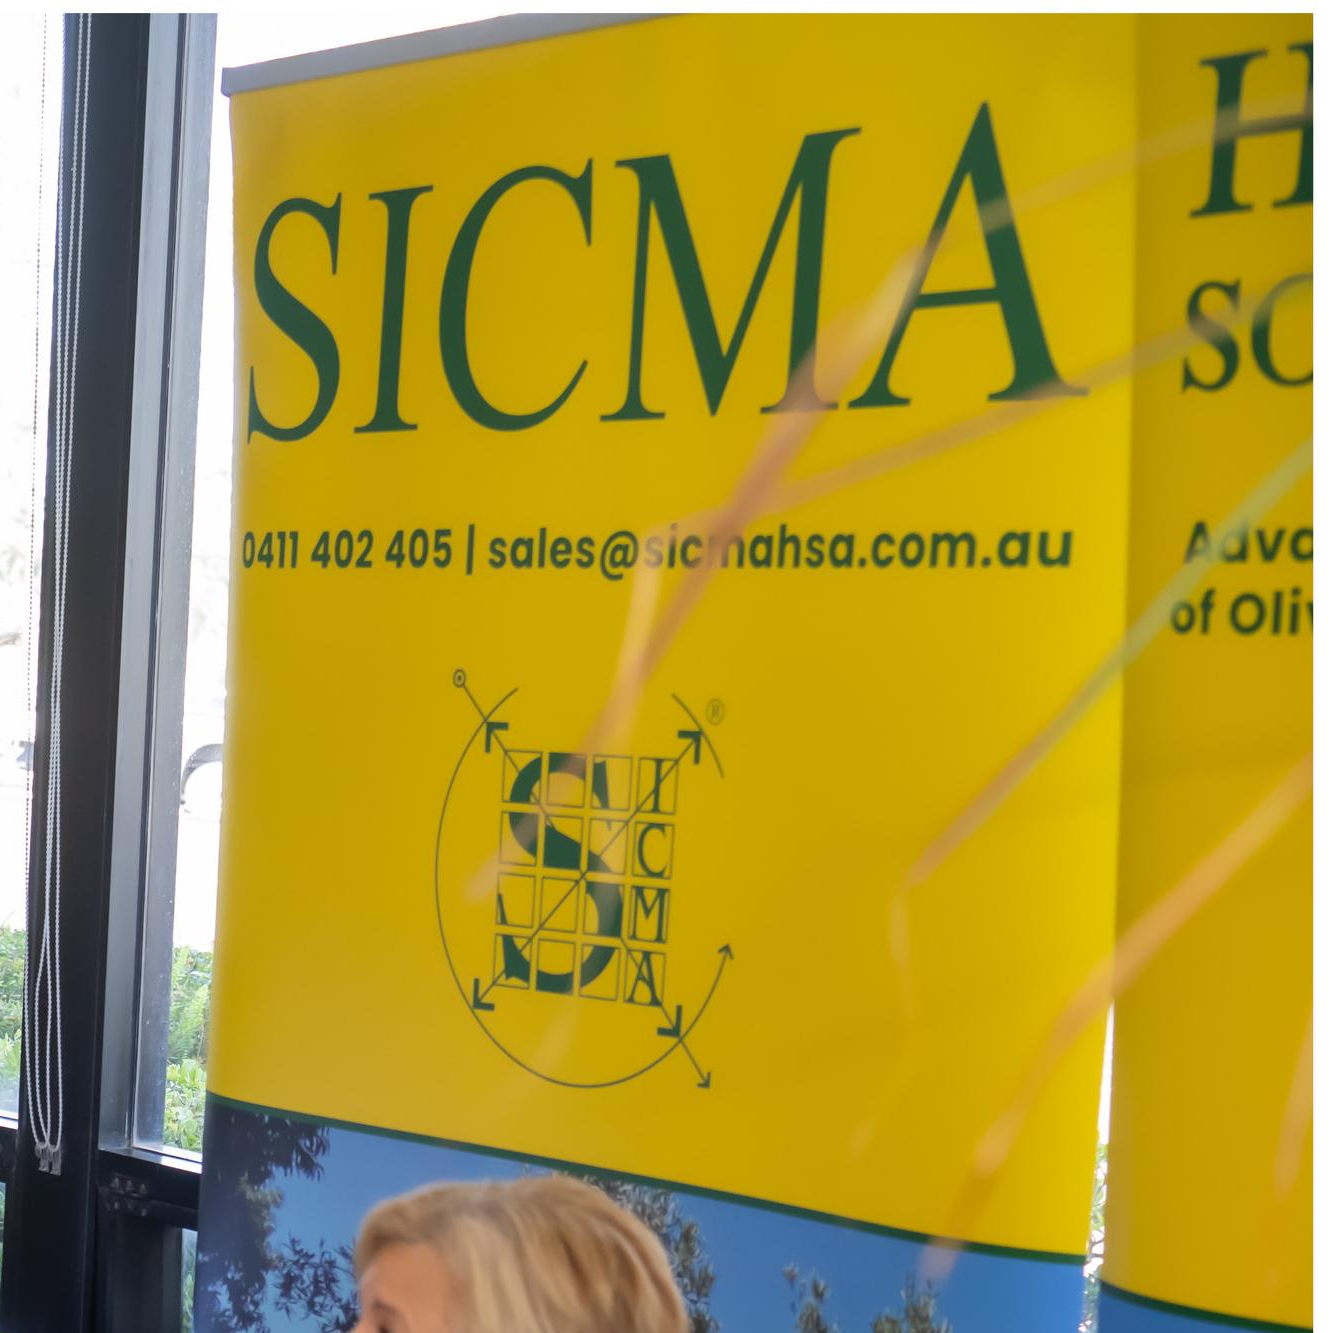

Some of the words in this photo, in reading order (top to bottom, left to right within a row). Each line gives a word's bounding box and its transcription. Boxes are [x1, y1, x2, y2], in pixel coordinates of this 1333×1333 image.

[247, 100, 1090, 445] SICMA
[242, 531, 299, 569] 0411
[311, 530, 375, 569] 402
[385, 528, 453, 569] 405
[488, 522, 1074, 581] sales@sicmahsa.com.au
[1171, 588, 1215, 635] of
